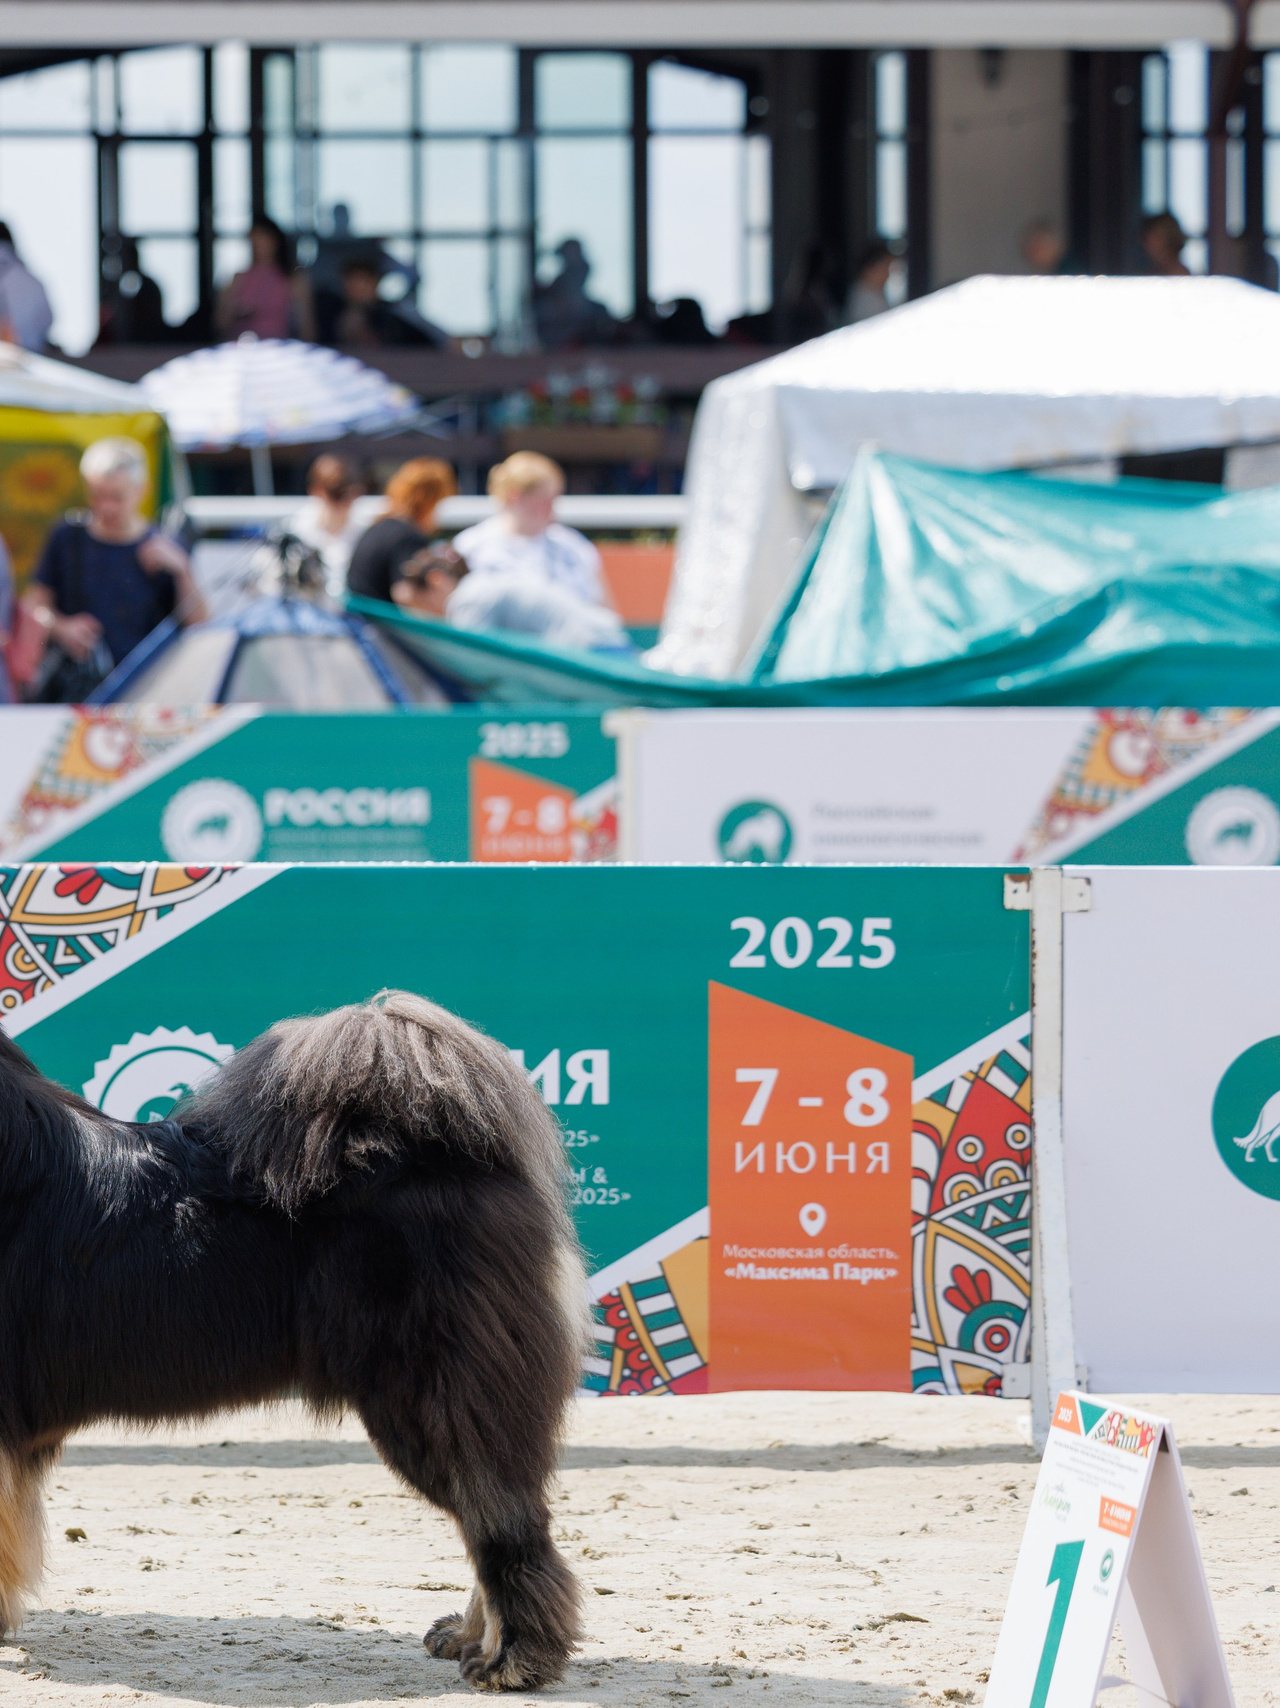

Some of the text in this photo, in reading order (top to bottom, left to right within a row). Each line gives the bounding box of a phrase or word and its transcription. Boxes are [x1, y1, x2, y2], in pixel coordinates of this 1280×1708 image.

[729, 916, 896, 969] 2025
[735, 1141, 890, 1174] ИЮНЯ
[722, 1243, 824, 1260] Московская
[724, 1262, 898, 1286] «Максима Парк»
[1028, 1538, 1086, 1708] 1
